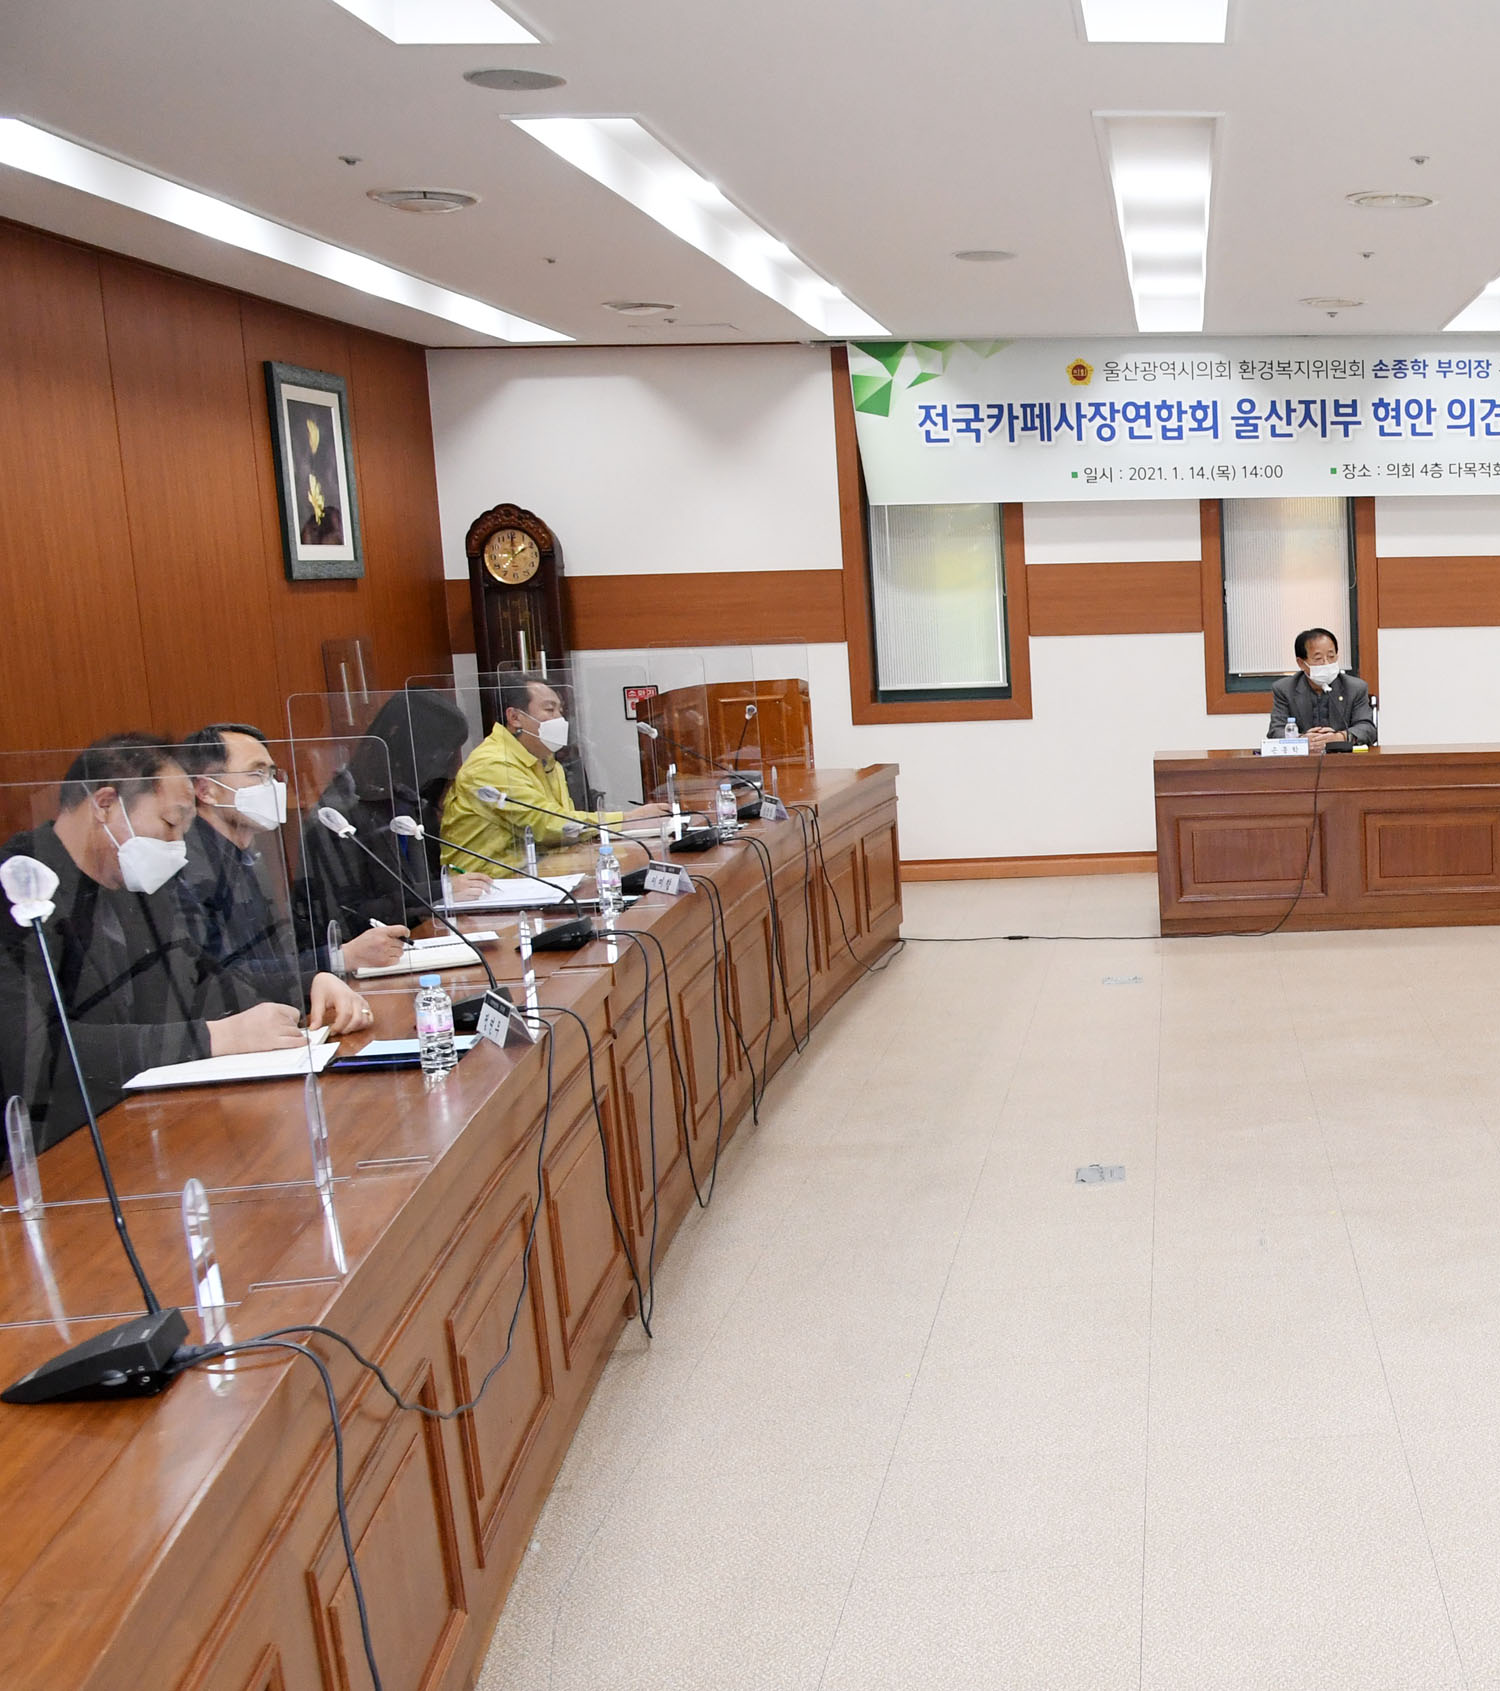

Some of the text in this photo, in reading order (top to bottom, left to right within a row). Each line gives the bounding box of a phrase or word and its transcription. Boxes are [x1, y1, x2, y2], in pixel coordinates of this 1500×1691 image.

[1103, 360, 1231, 382] 울산광역시의회
[1238, 359, 1366, 381] 환경복지위원회
[1371, 359, 1429, 380] 손종학
[1436, 358, 1493, 379] 부의장
[917, 400, 1219, 444] 전국카페사장연합회
[1231, 397, 1362, 440] 울산지부
[1372, 397, 1437, 438] 현안
[1083, 466, 1113, 484] 일시
[1128, 466, 1168, 481] 2021.
[1172, 466, 1184, 481] 1.
[1189, 465, 1236, 481] 14.(목)
[1242, 464, 1283, 479] 14:00
[1342, 463, 1372, 480] 장소
[1386, 463, 1415, 479] 의회
[1420, 462, 1444, 479] 4층
